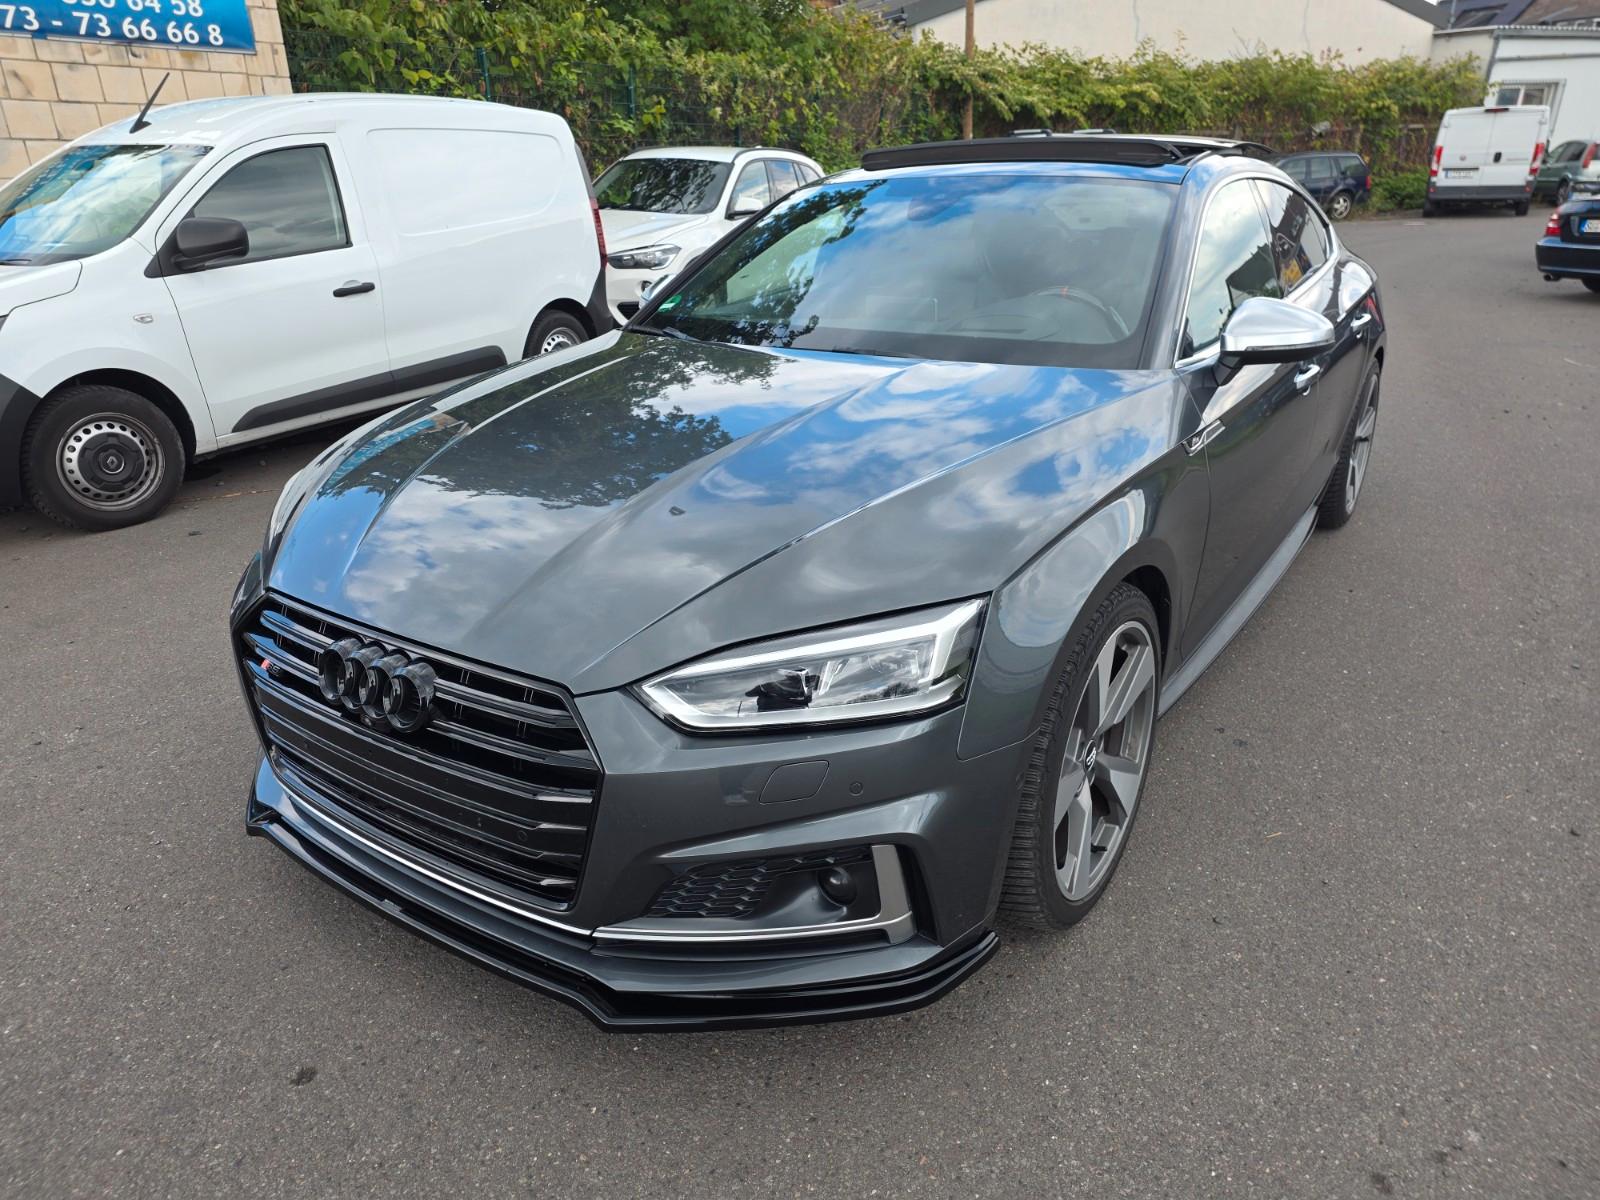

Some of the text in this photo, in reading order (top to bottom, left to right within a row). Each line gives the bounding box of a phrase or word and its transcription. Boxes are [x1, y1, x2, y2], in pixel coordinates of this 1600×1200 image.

[172, 0, 203, 17] 58
[0, 4, 40, 31] 73
[72, 11, 111, 37] 73
[122, 16, 157, 41] 66
[167, 21, 199, 44] 66
[207, 24, 223, 46] 8
